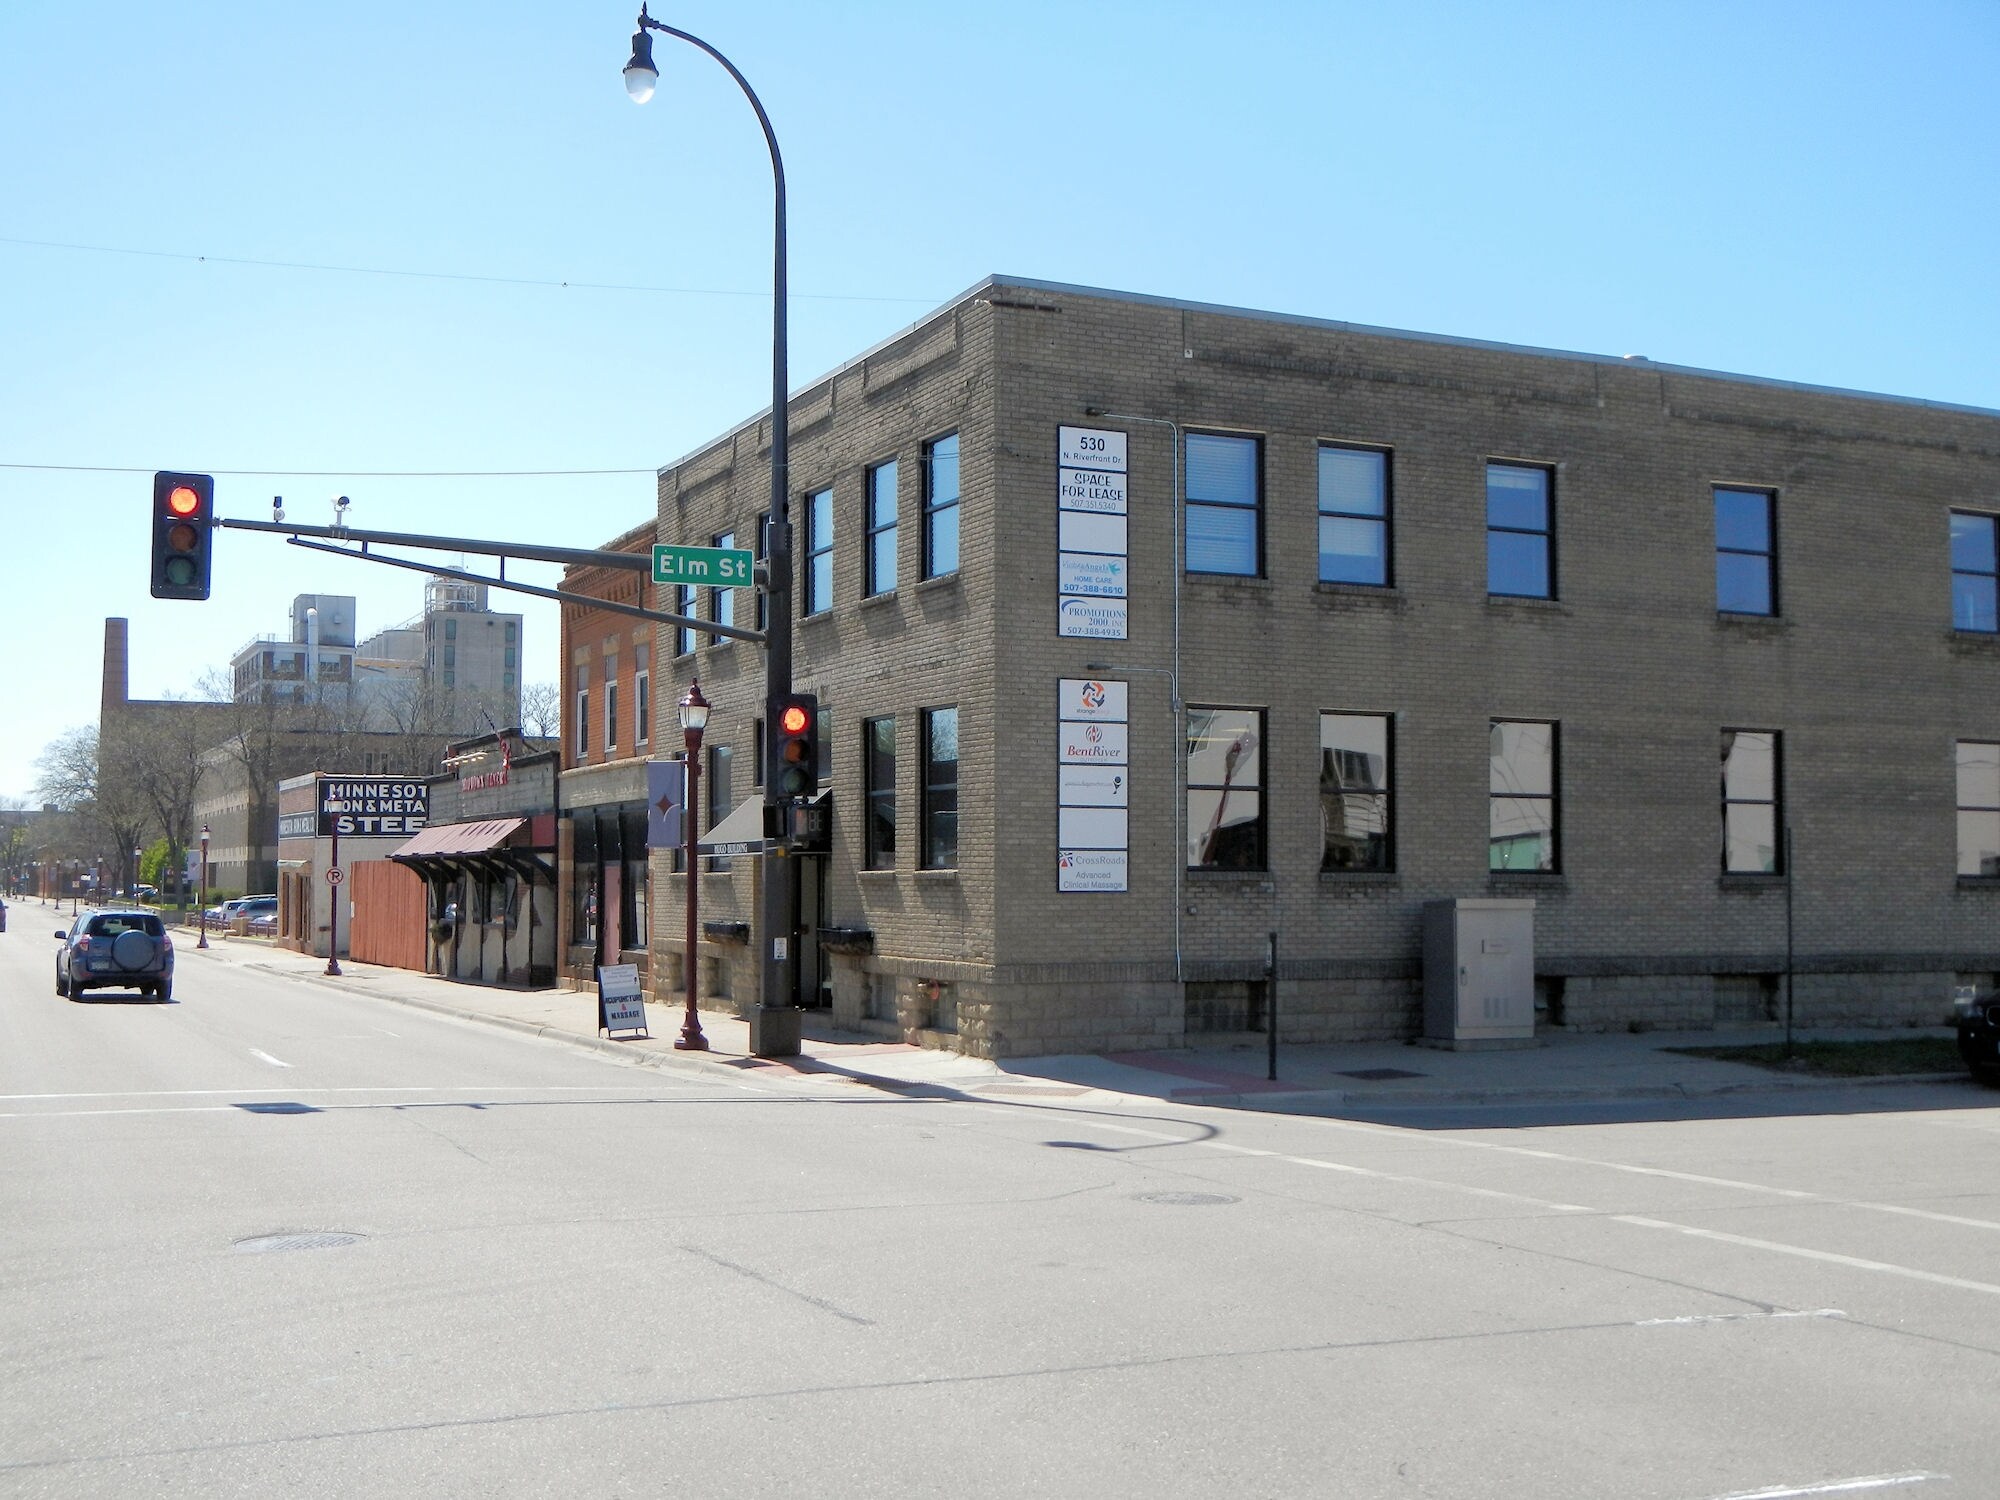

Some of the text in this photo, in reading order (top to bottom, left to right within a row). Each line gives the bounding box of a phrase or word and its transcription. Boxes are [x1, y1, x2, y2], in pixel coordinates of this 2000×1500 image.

[1080, 437, 1105, 451] 530
[1074, 453, 1110, 463] Riverfront
[1075, 473, 1111, 487] SPACE
[1063, 486, 1124, 501] FOR LEASE
[660, 555, 745, 578] Elm St
[1069, 608, 1127, 618] PROMOTIONS
[1089, 618, 1108, 626] 2000
[1067, 745, 1120, 757] BentRiver
[324, 800, 425, 812] ION & META
[337, 817, 427, 832] STEE
[1076, 856, 1125, 864] CrossRoads
